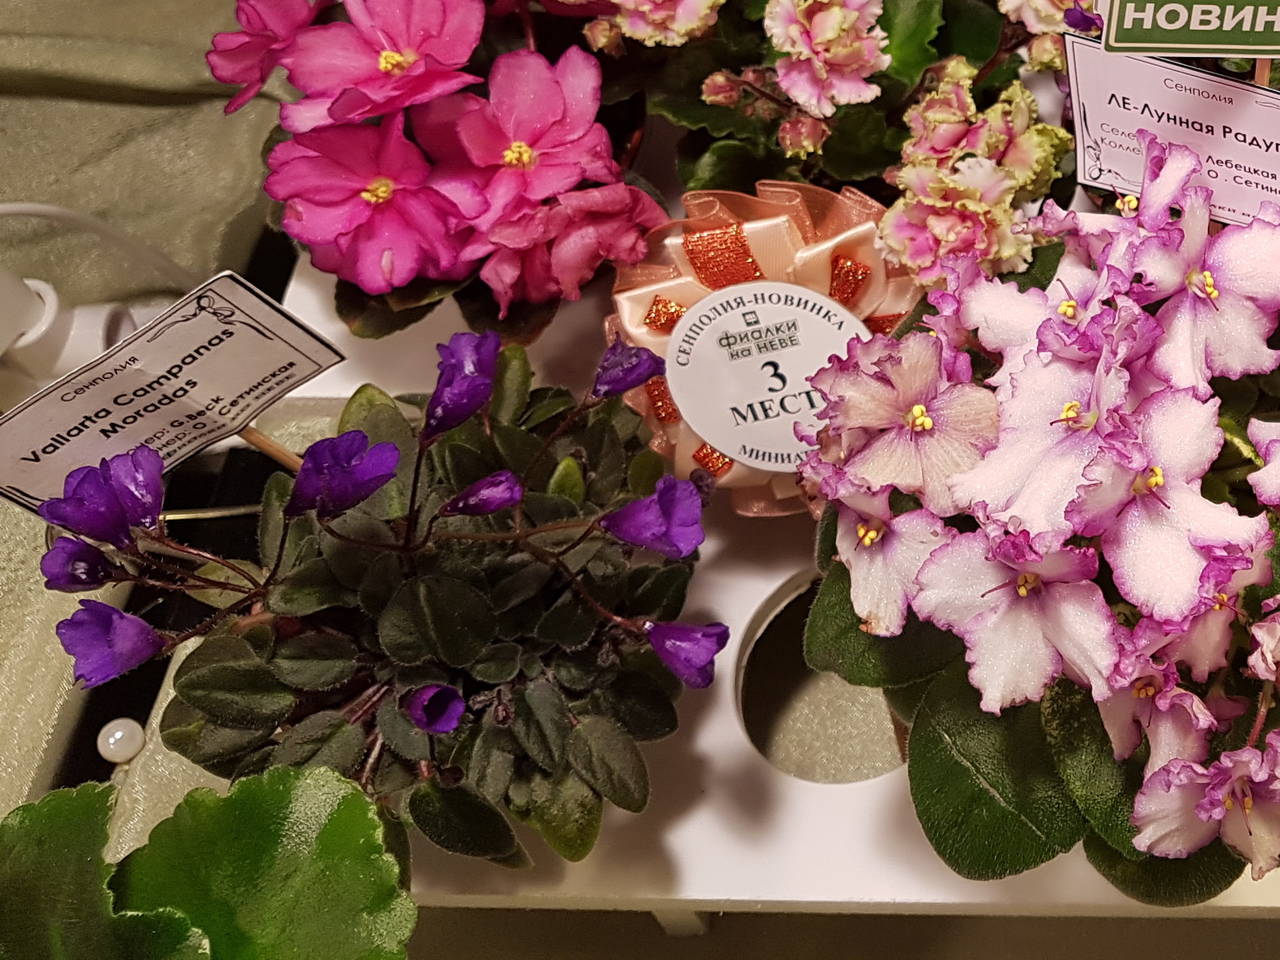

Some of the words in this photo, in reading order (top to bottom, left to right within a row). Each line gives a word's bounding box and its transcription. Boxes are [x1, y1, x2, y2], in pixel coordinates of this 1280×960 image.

[1163, 78, 1234, 105] Сенполия
[1108, 93, 1214, 136] ЛЕ-Лунная
[1206, 155, 1277, 180] Лебецкая
[676, 293, 845, 367] СЕНПОЛИЯ-НОВИНКА
[758, 336, 798, 353] НЕВЕ
[21, 407, 113, 465] Vallarta
[113, 327, 236, 407] Campanas
[61, 356, 139, 403] Сенполия
[218, 361, 296, 416] Сетинская
[761, 361, 787, 393] 3
[100, 378, 198, 440] Moradas
[170, 395, 224, 428] G.Beck
[730, 390, 826, 427] МЕСТ
